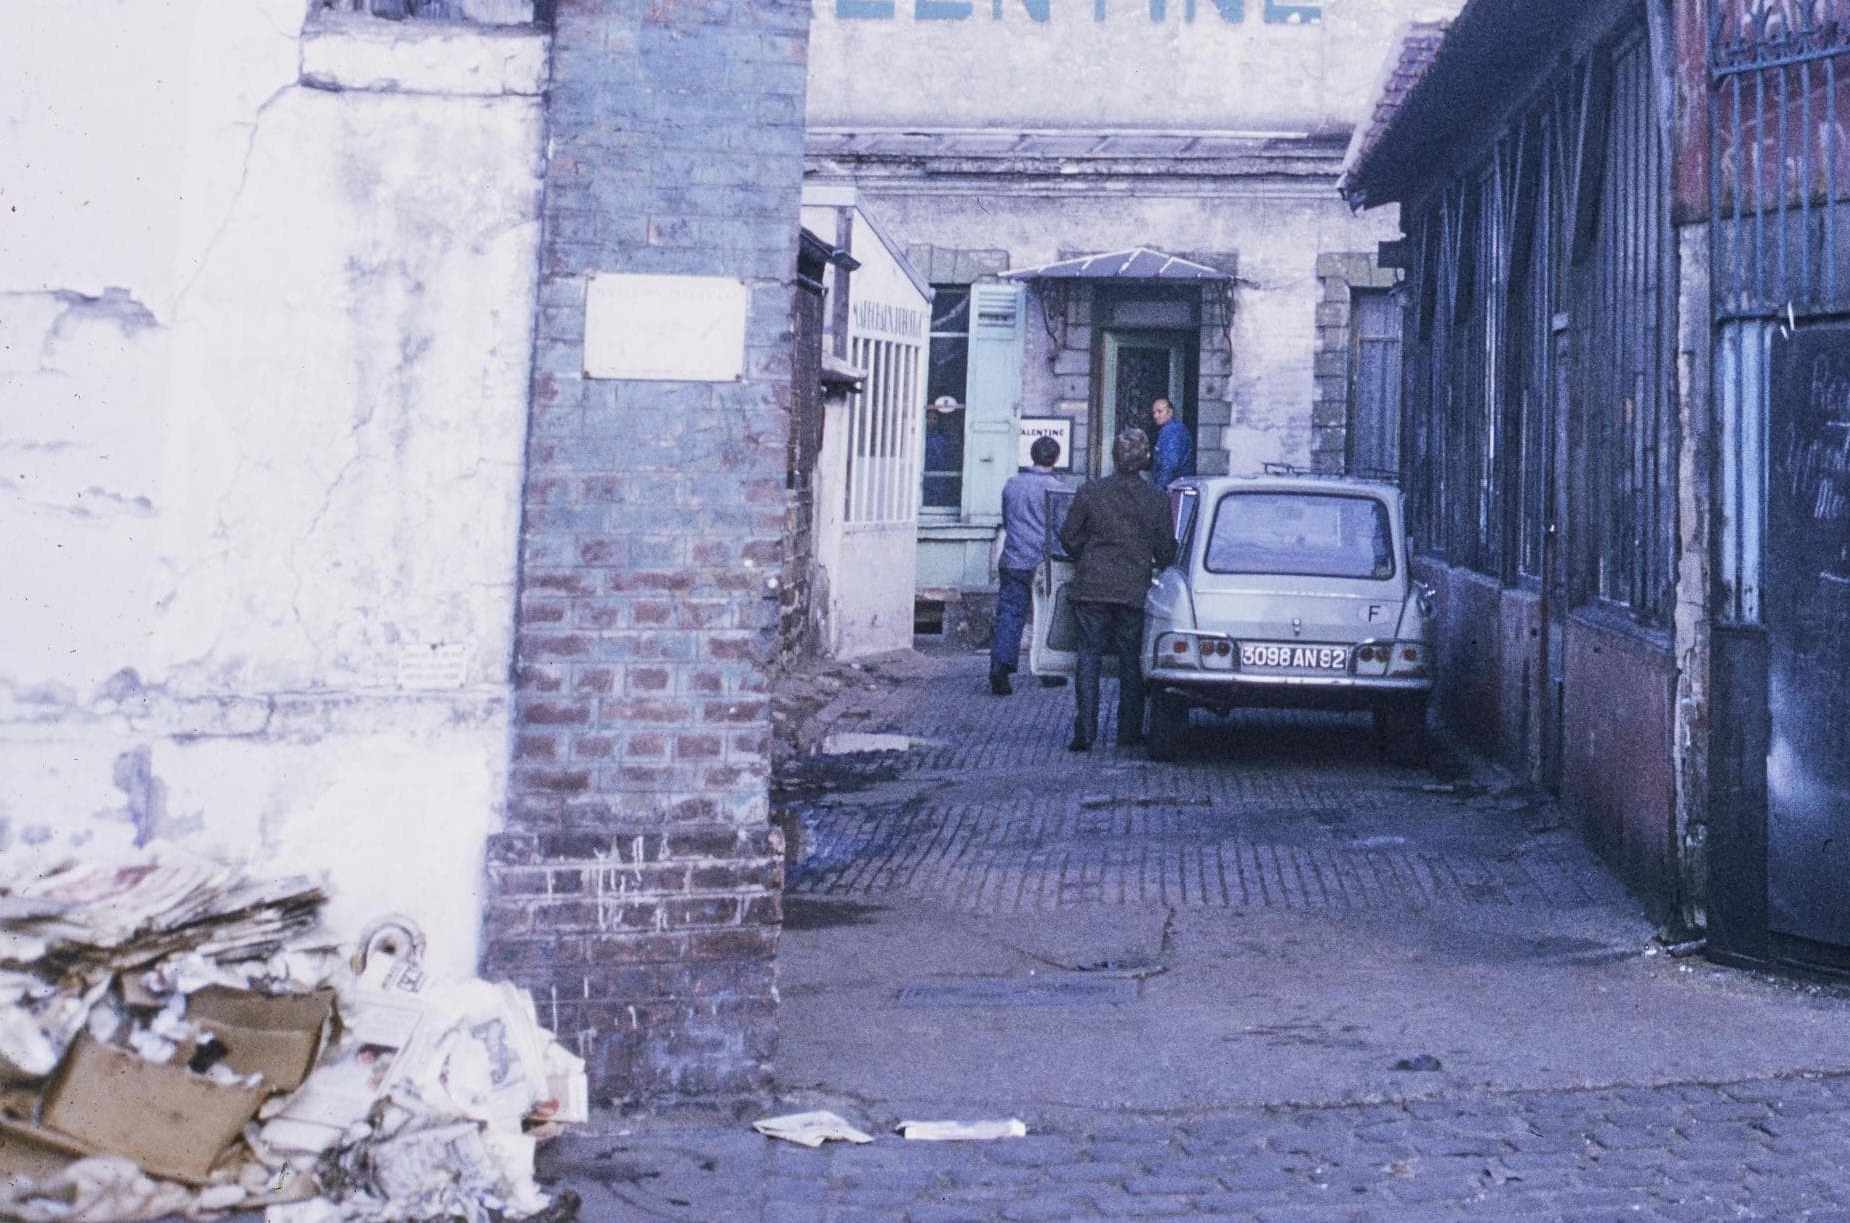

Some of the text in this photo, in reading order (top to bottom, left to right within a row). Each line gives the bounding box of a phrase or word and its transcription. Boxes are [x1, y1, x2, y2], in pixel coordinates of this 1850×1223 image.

[1019, 427, 1064, 437] ALENTINE
[1368, 605, 1381, 622] F
[1242, 645, 1291, 666] 3098
[1293, 648, 1316, 668] AN
